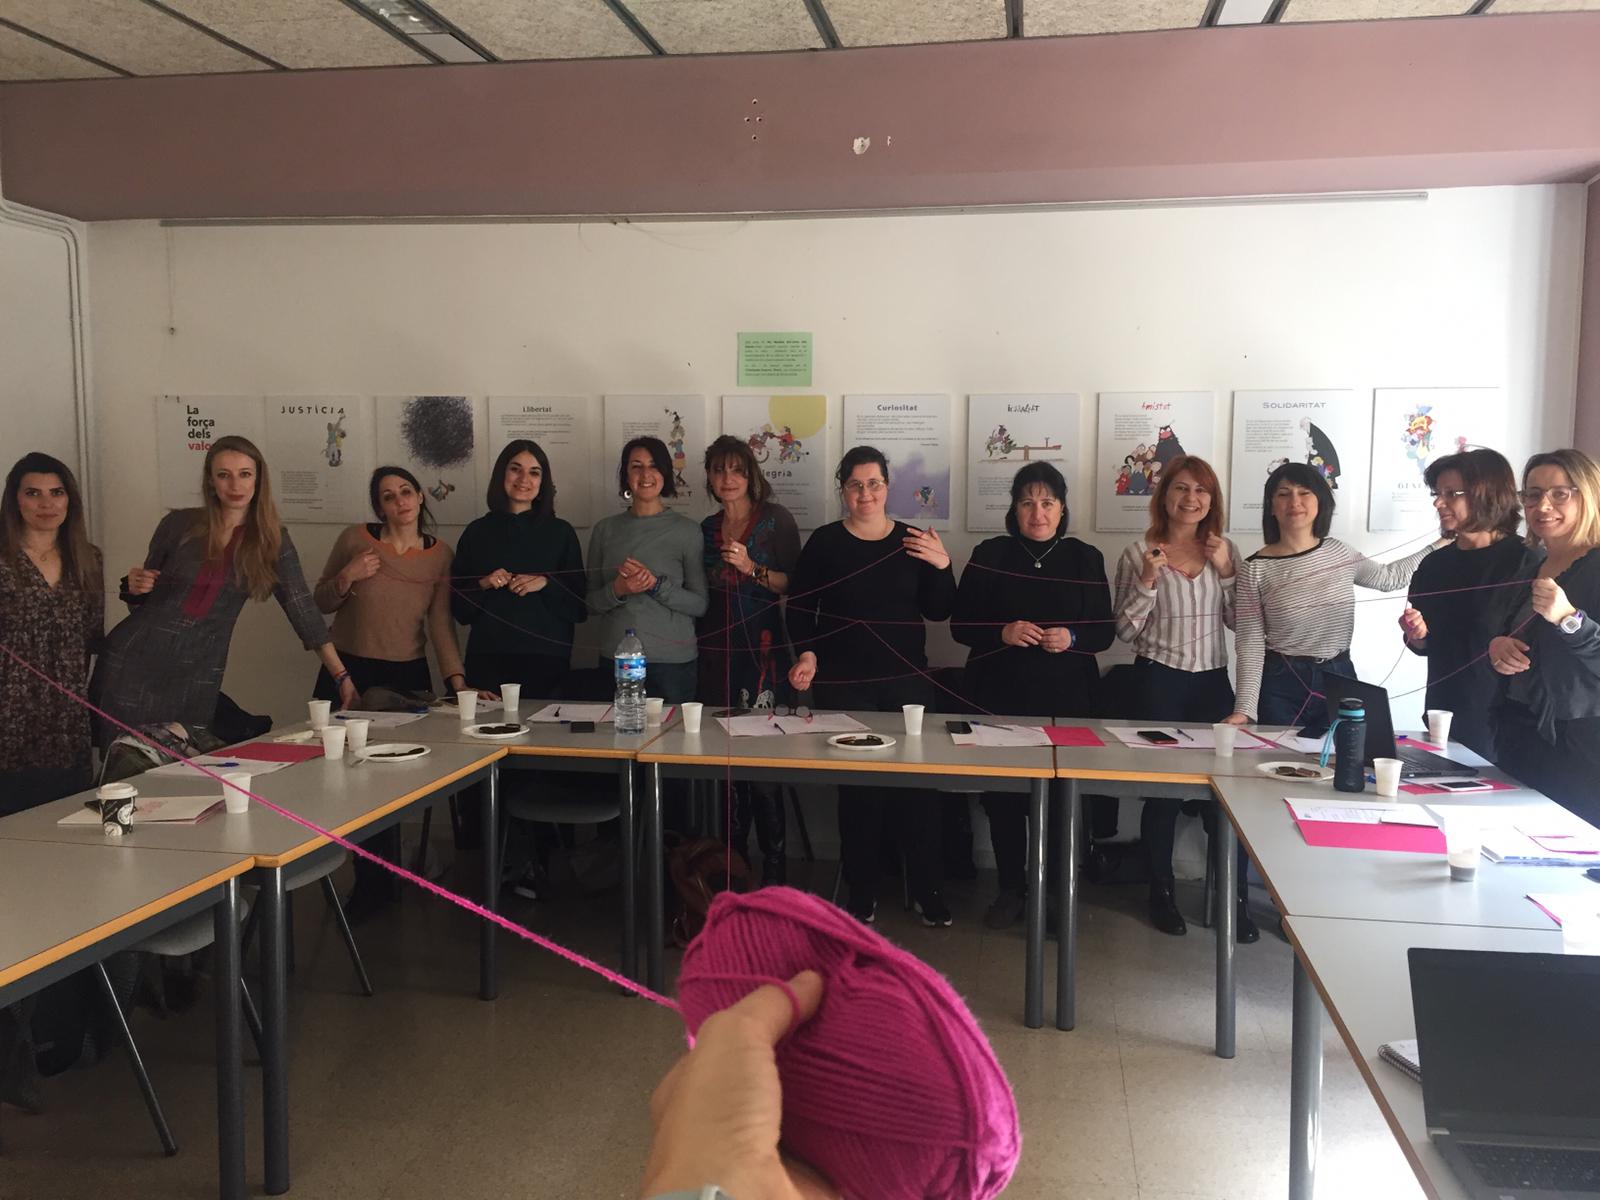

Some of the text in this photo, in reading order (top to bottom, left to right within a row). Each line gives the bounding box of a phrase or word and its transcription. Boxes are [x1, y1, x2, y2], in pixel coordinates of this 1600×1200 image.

[187, 404, 199, 415] La
[876, 403, 918, 412] Curiositat
[1262, 401, 1327, 409] SOLIDARITAT
[187, 416, 215, 430] força
[187, 428, 211, 439] dels
[188, 440, 213, 450] valo
[761, 469, 793, 479] legria
